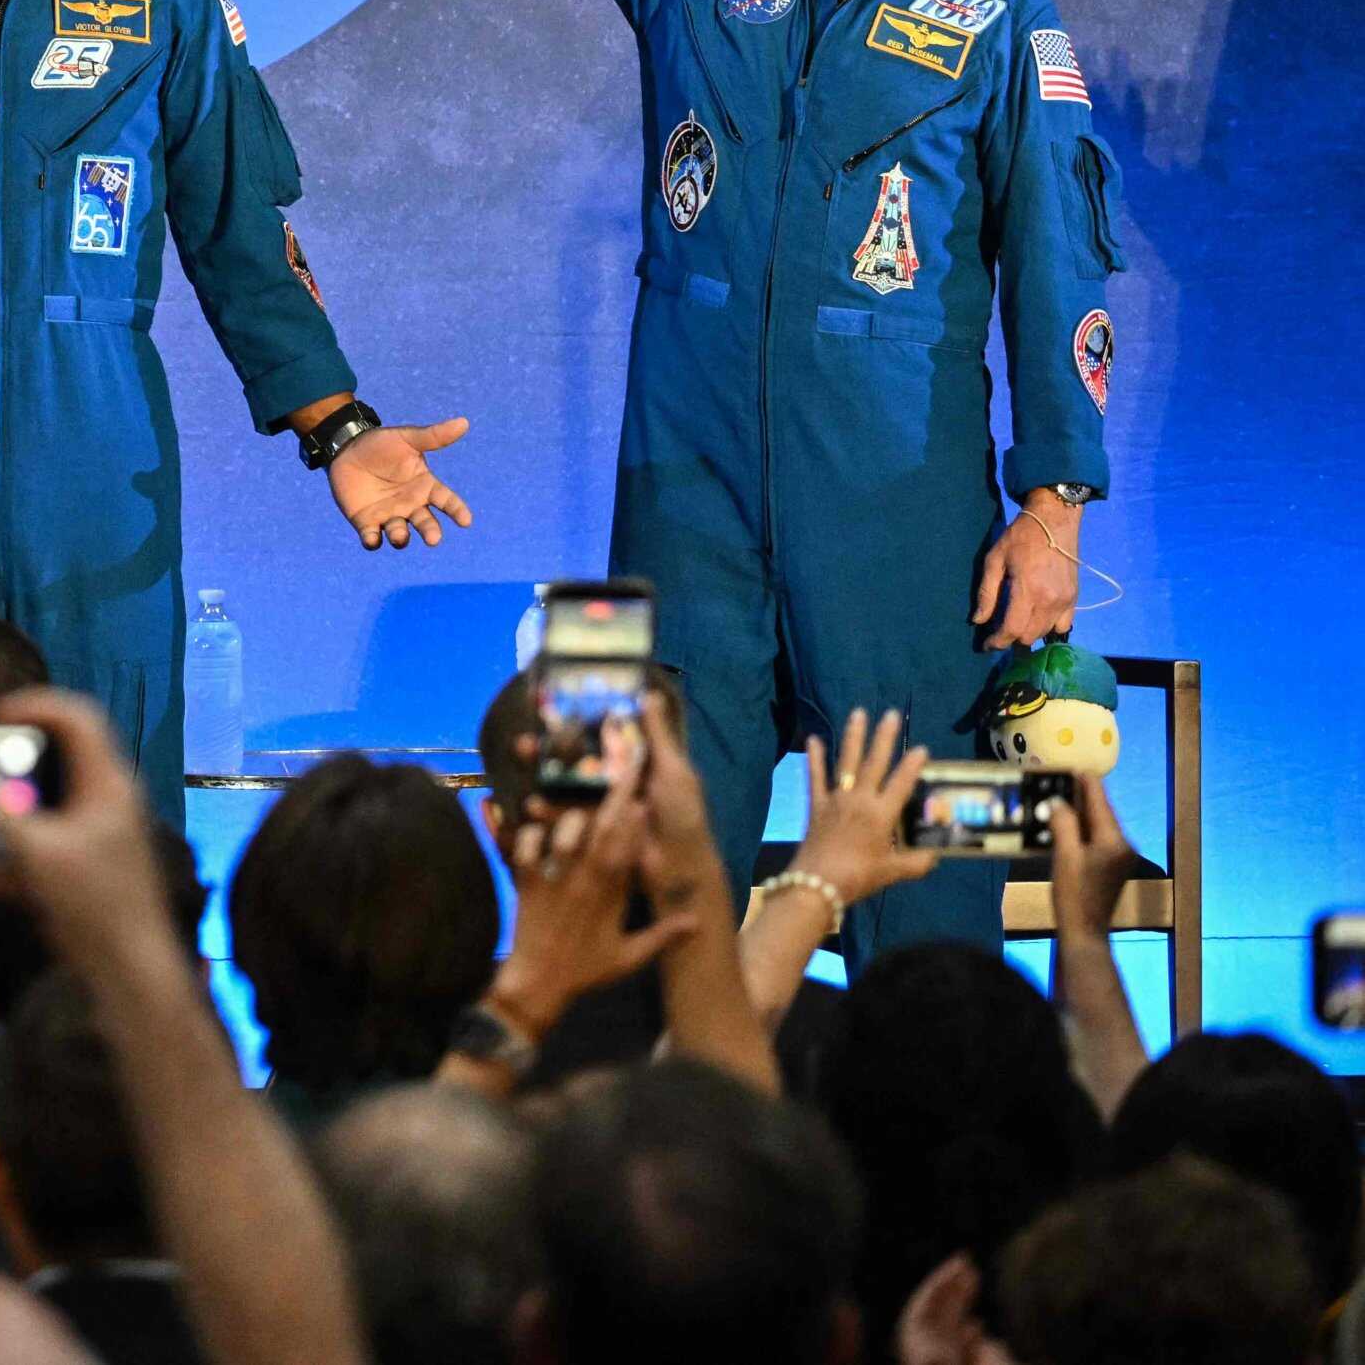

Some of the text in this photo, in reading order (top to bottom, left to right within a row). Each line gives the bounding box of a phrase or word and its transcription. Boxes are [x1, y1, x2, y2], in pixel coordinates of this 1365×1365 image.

[74, 22, 132, 35] VICTOR GLOVER
[43, 45, 100, 80] 25
[908, 45, 944, 66] WISEMAN
[75, 202, 110, 248] 65
